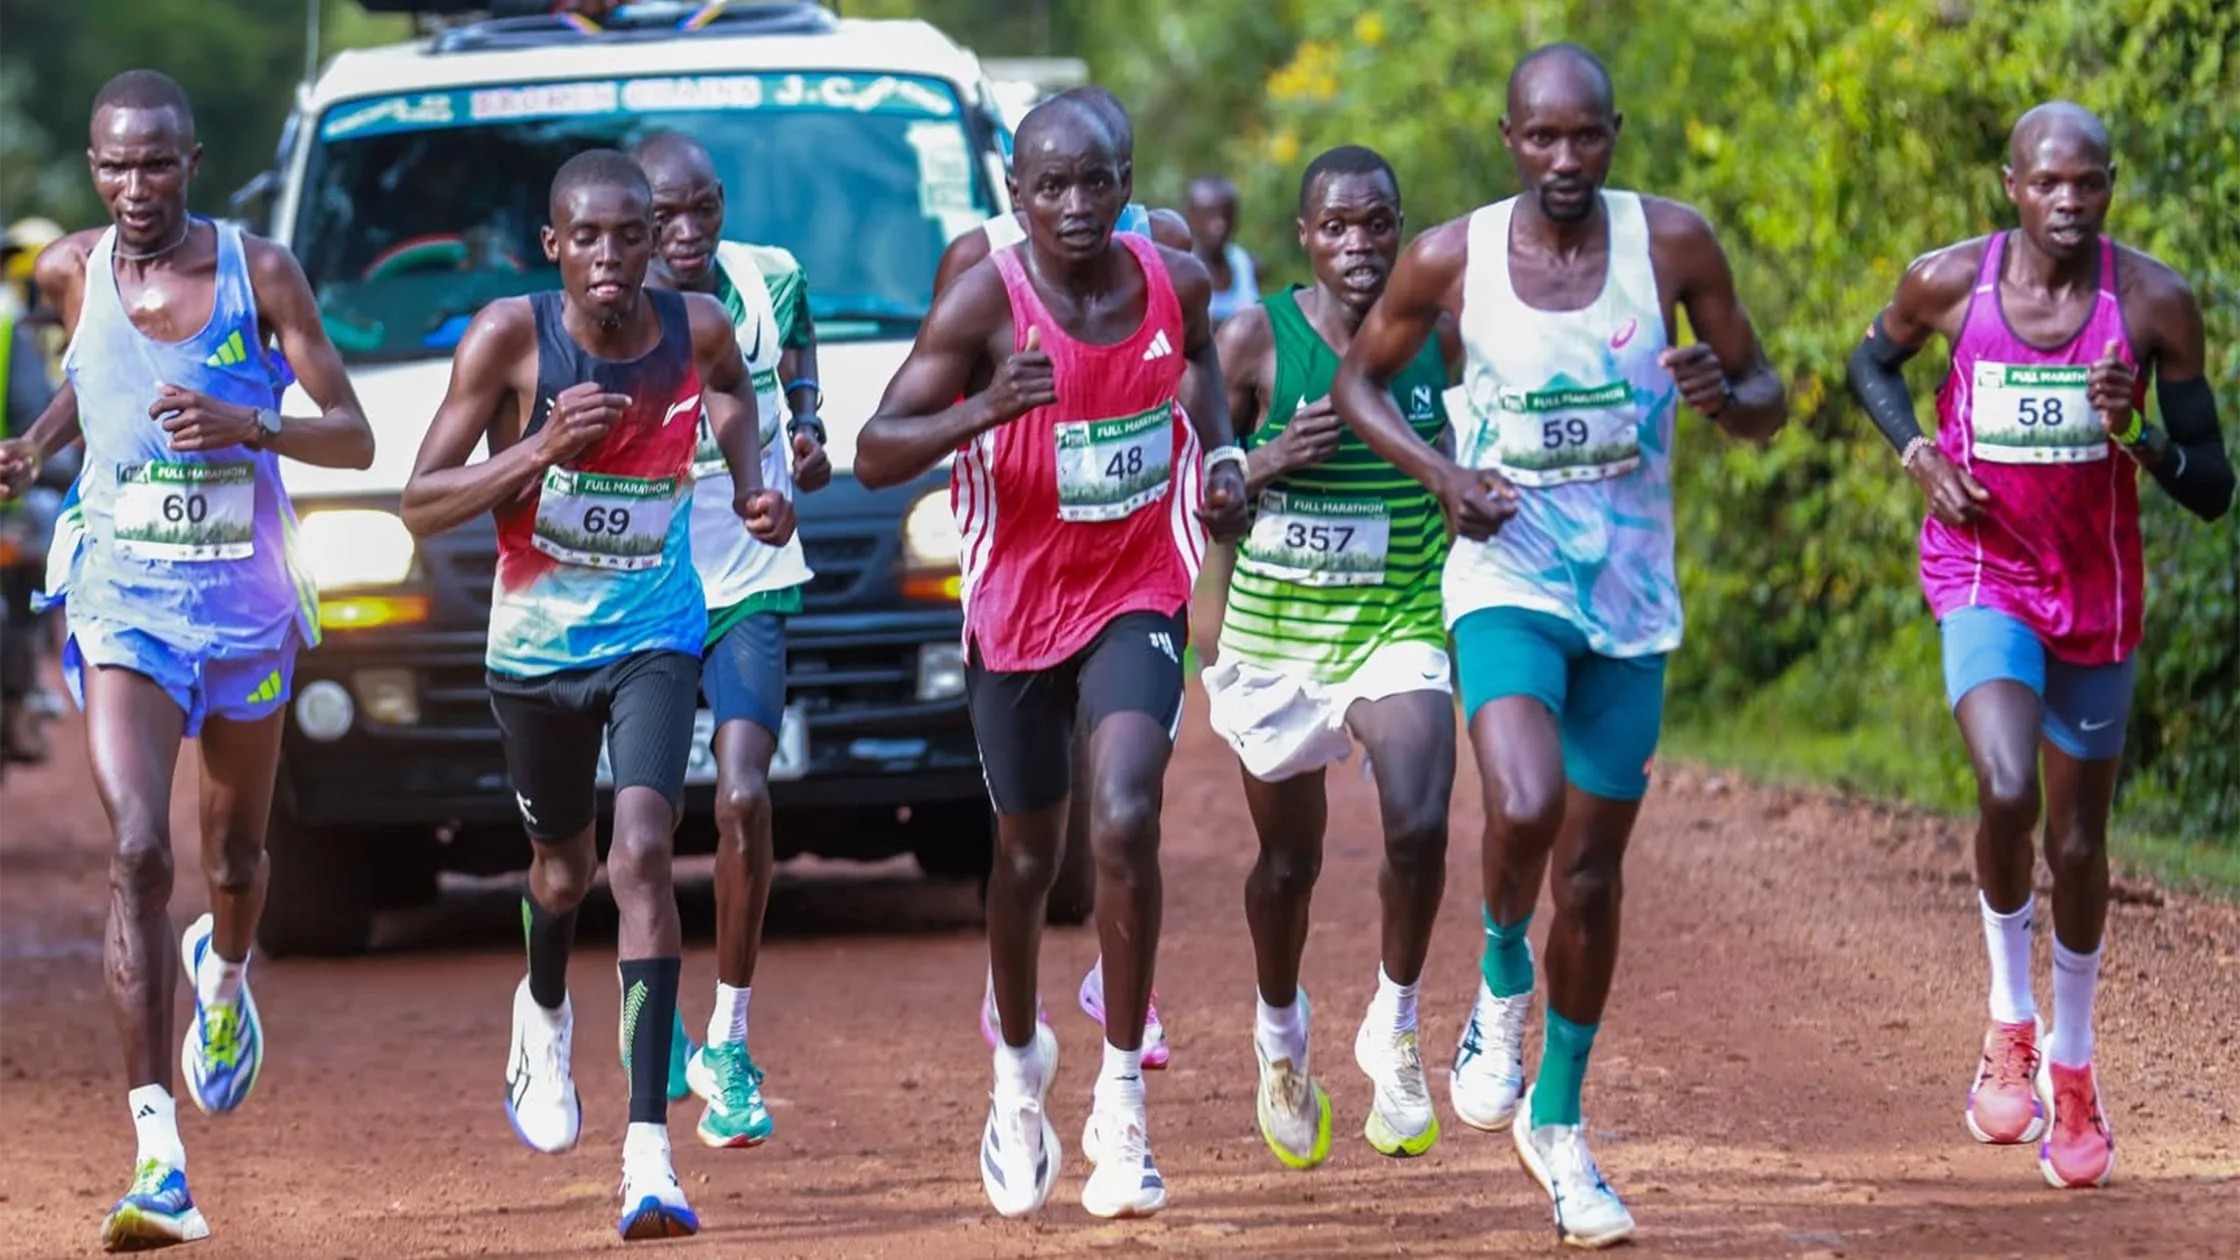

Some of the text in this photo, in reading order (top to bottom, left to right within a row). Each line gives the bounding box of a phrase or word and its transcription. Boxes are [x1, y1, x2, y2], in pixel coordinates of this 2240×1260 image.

[2011, 371, 2087, 383] FULL MARATH
[1533, 396, 1559, 408] FULL
[2018, 397, 2063, 426] 58
[1097, 424, 1123, 438] FULL
[1543, 418, 1589, 449] 59
[158, 466, 247, 479] FULL MARATHON
[1105, 446, 1143, 480] 48
[584, 479, 670, 495] FULL MARATHON
[163, 494, 207, 523] 60
[1293, 500, 1385, 513] FULL MARATHON
[583, 506, 630, 535] 69
[1285, 521, 1355, 553] 357
